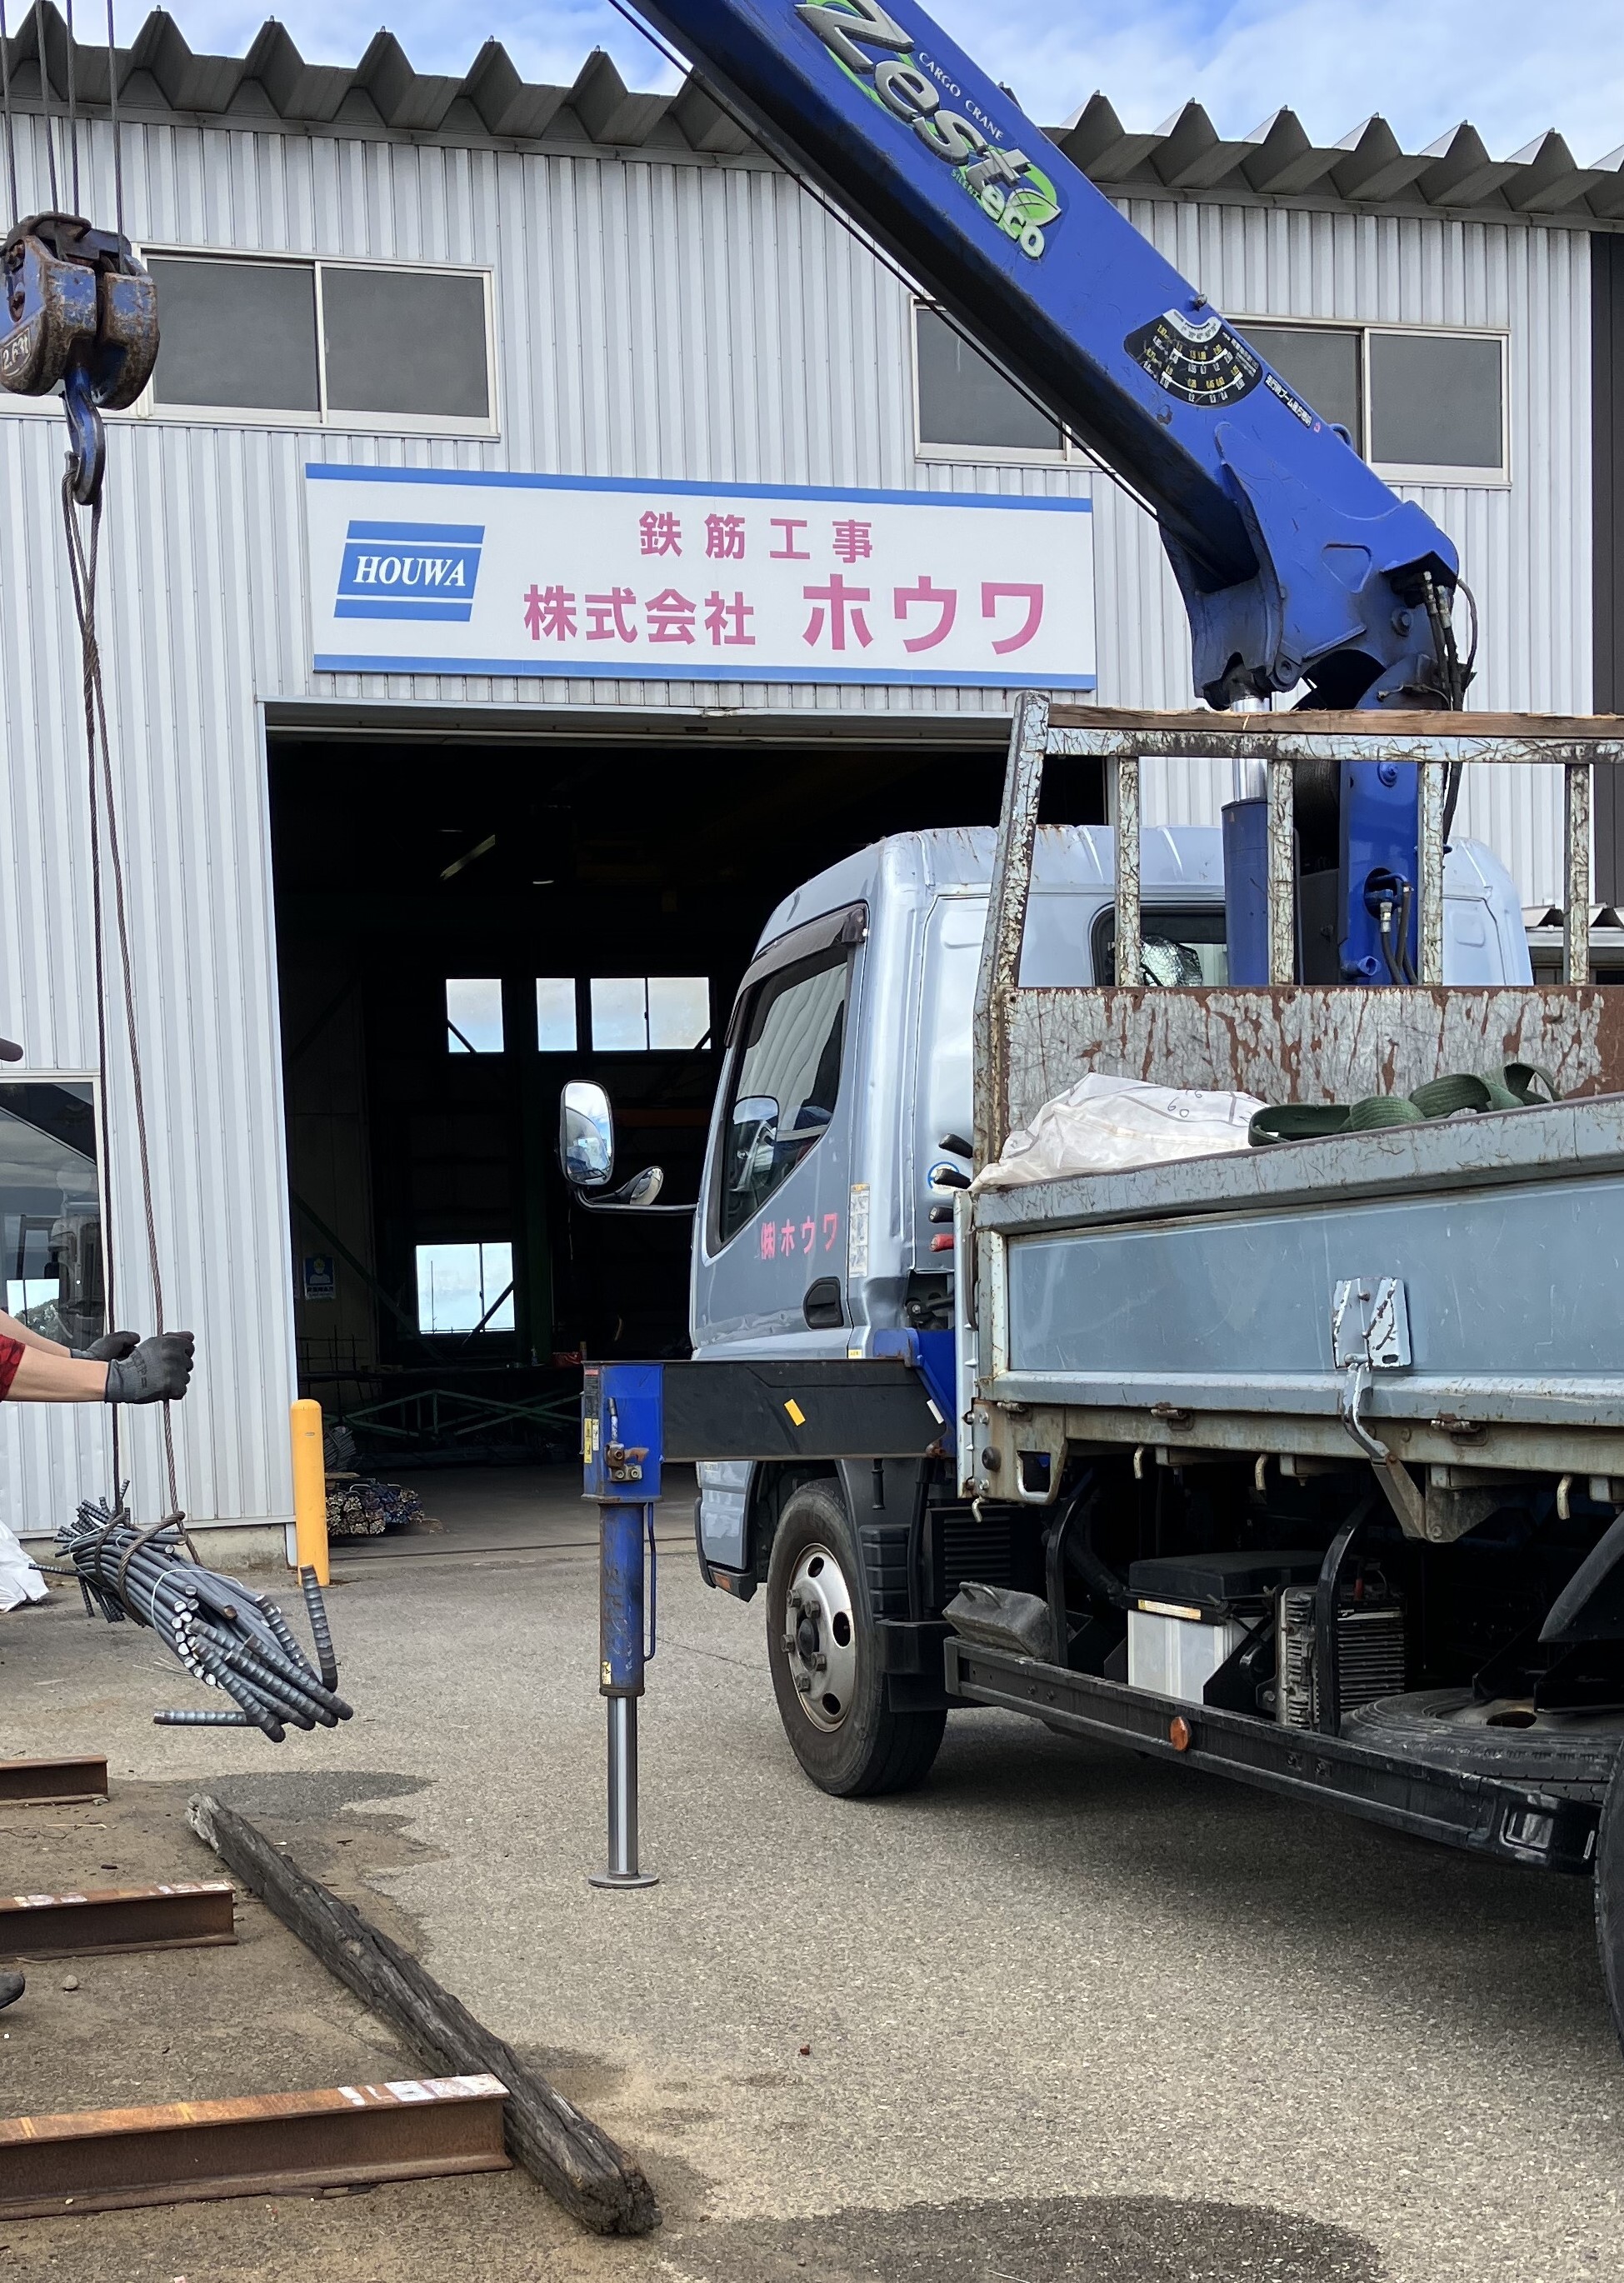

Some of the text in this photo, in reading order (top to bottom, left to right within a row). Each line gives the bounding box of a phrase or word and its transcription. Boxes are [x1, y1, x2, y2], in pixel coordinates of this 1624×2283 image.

[794, 0, 1032, 195] Zest
[918, 52, 1004, 142] CARGO CRANE
[352, 556, 466, 587] HOUWA
[638, 510, 872, 563] 鉄筋工事
[523, 573, 1043, 655] 株式会社 ホウワ
